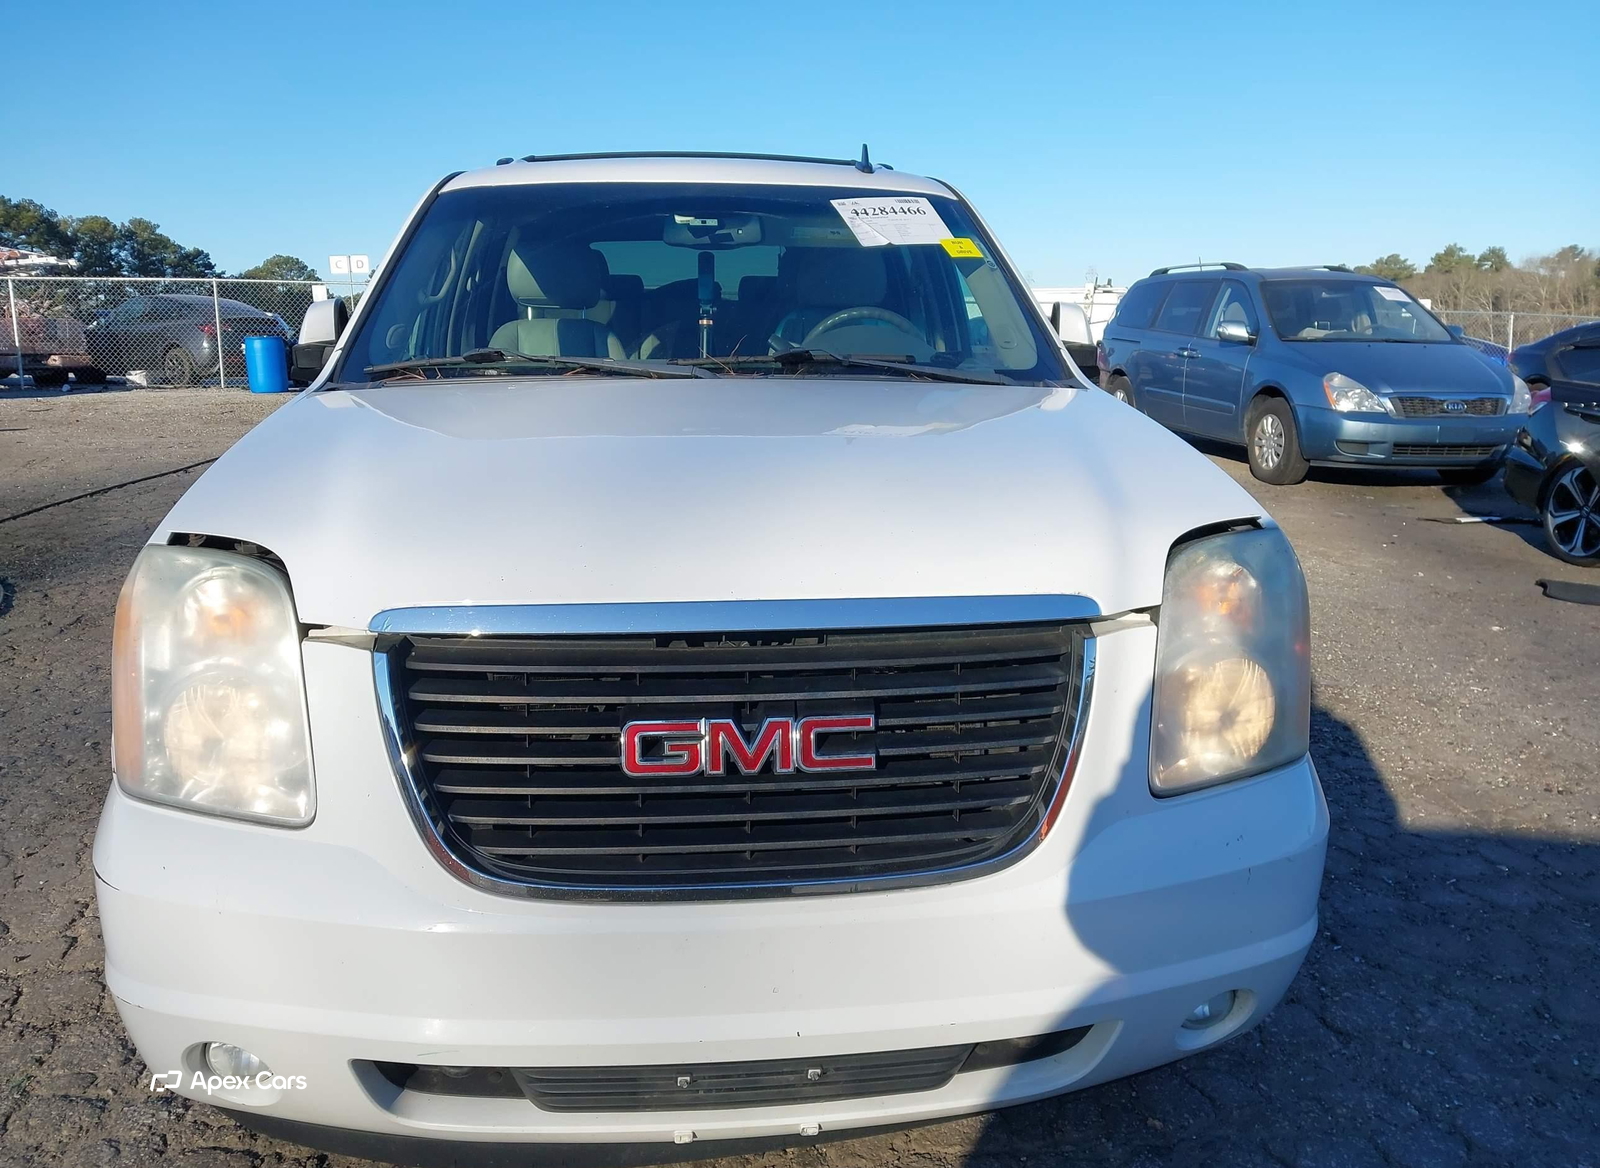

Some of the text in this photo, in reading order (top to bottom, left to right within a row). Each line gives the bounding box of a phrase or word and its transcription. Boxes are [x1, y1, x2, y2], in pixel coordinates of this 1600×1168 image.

[850, 205, 927, 217] 44284466
[335, 260, 342, 269] C
[356, 260, 364, 269] D
[621, 714, 876, 777] GMC
